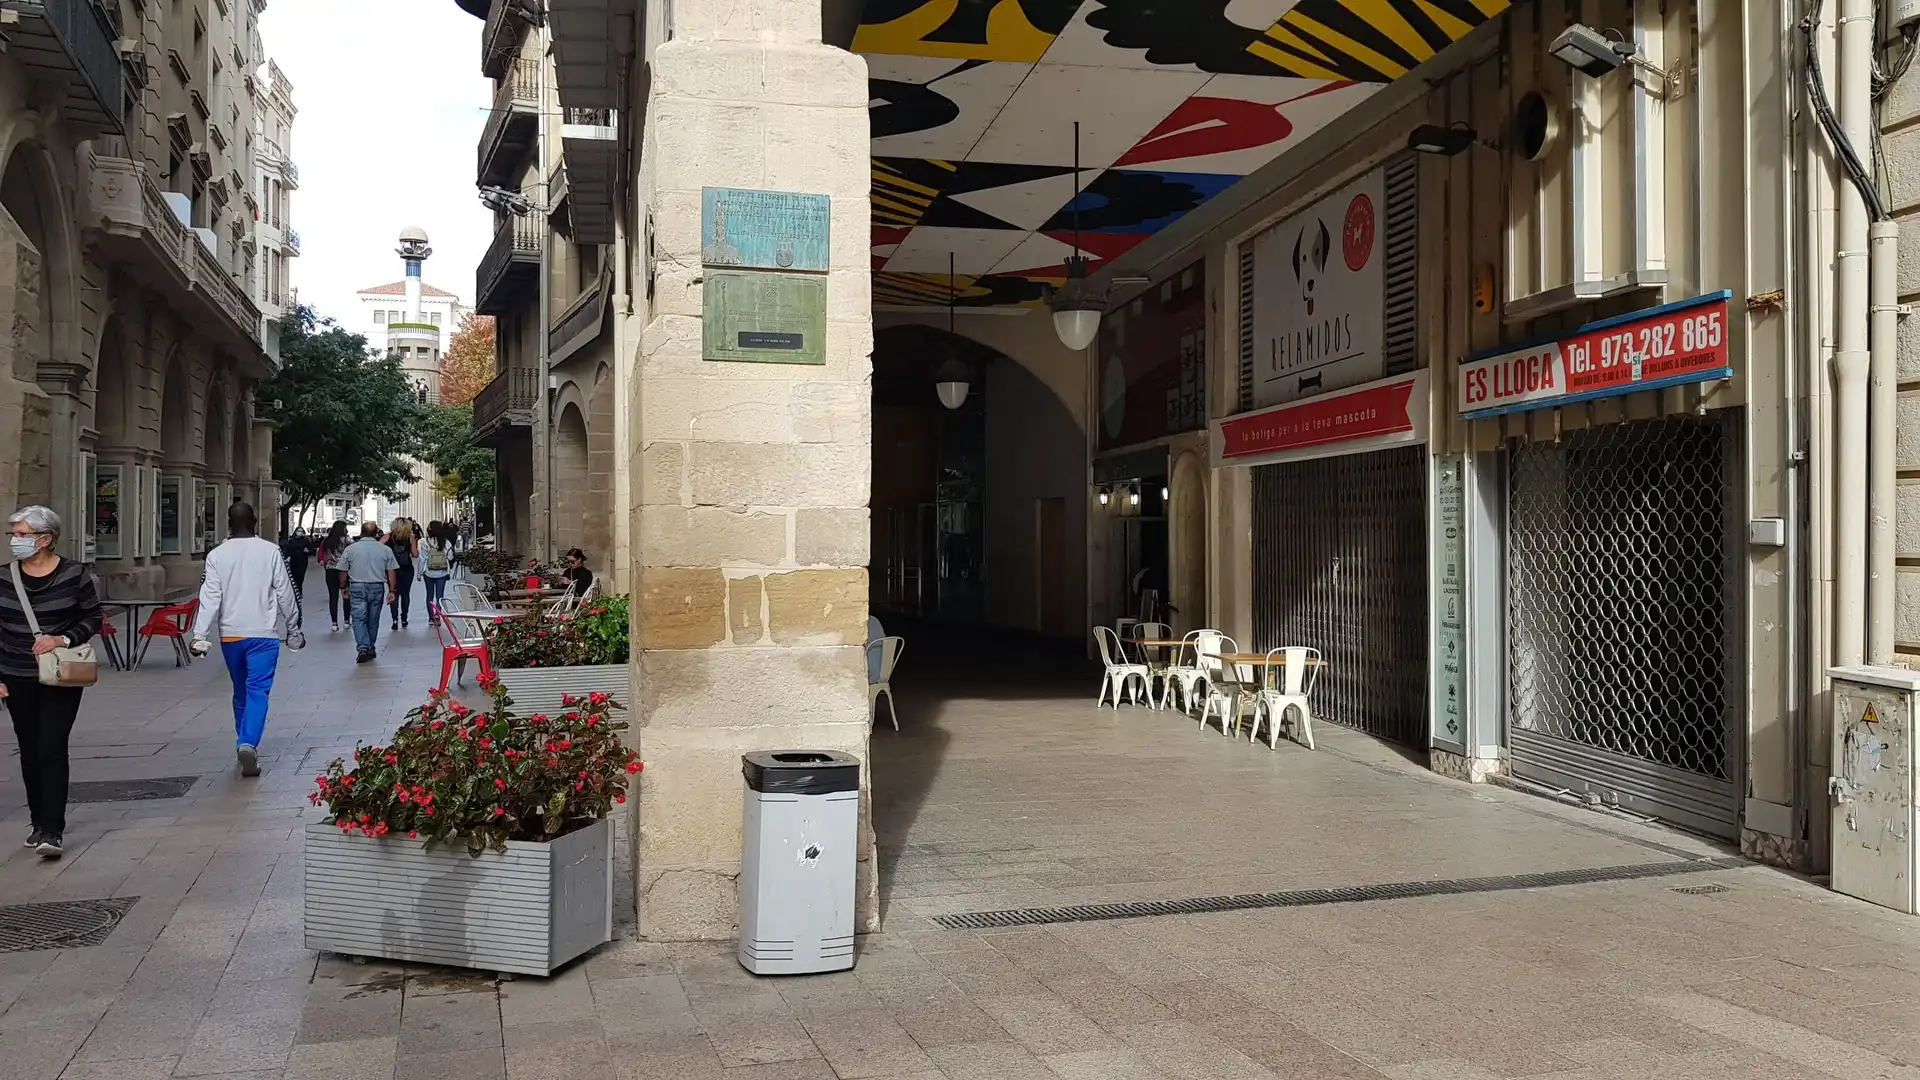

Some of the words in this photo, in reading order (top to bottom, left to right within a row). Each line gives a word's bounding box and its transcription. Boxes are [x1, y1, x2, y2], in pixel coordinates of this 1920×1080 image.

[1272, 313, 1351, 371] RELAMIDOS
[1568, 341, 1596, 374] Tel.
[1601, 332, 1634, 368] 973
[1640, 323, 1675, 360] 282
[1682, 312, 1721, 352] 865
[1466, 368, 1487, 404] ES
[1494, 352, 1554, 398] LLOGA
[1242, 431, 1248, 442] la
[1251, 427, 1275, 440] botiga
[1278, 427, 1290, 438] per
[1301, 419, 1309, 432] la
[1313, 417, 1332, 430] teva
[1335, 407, 1377, 425] mascota
